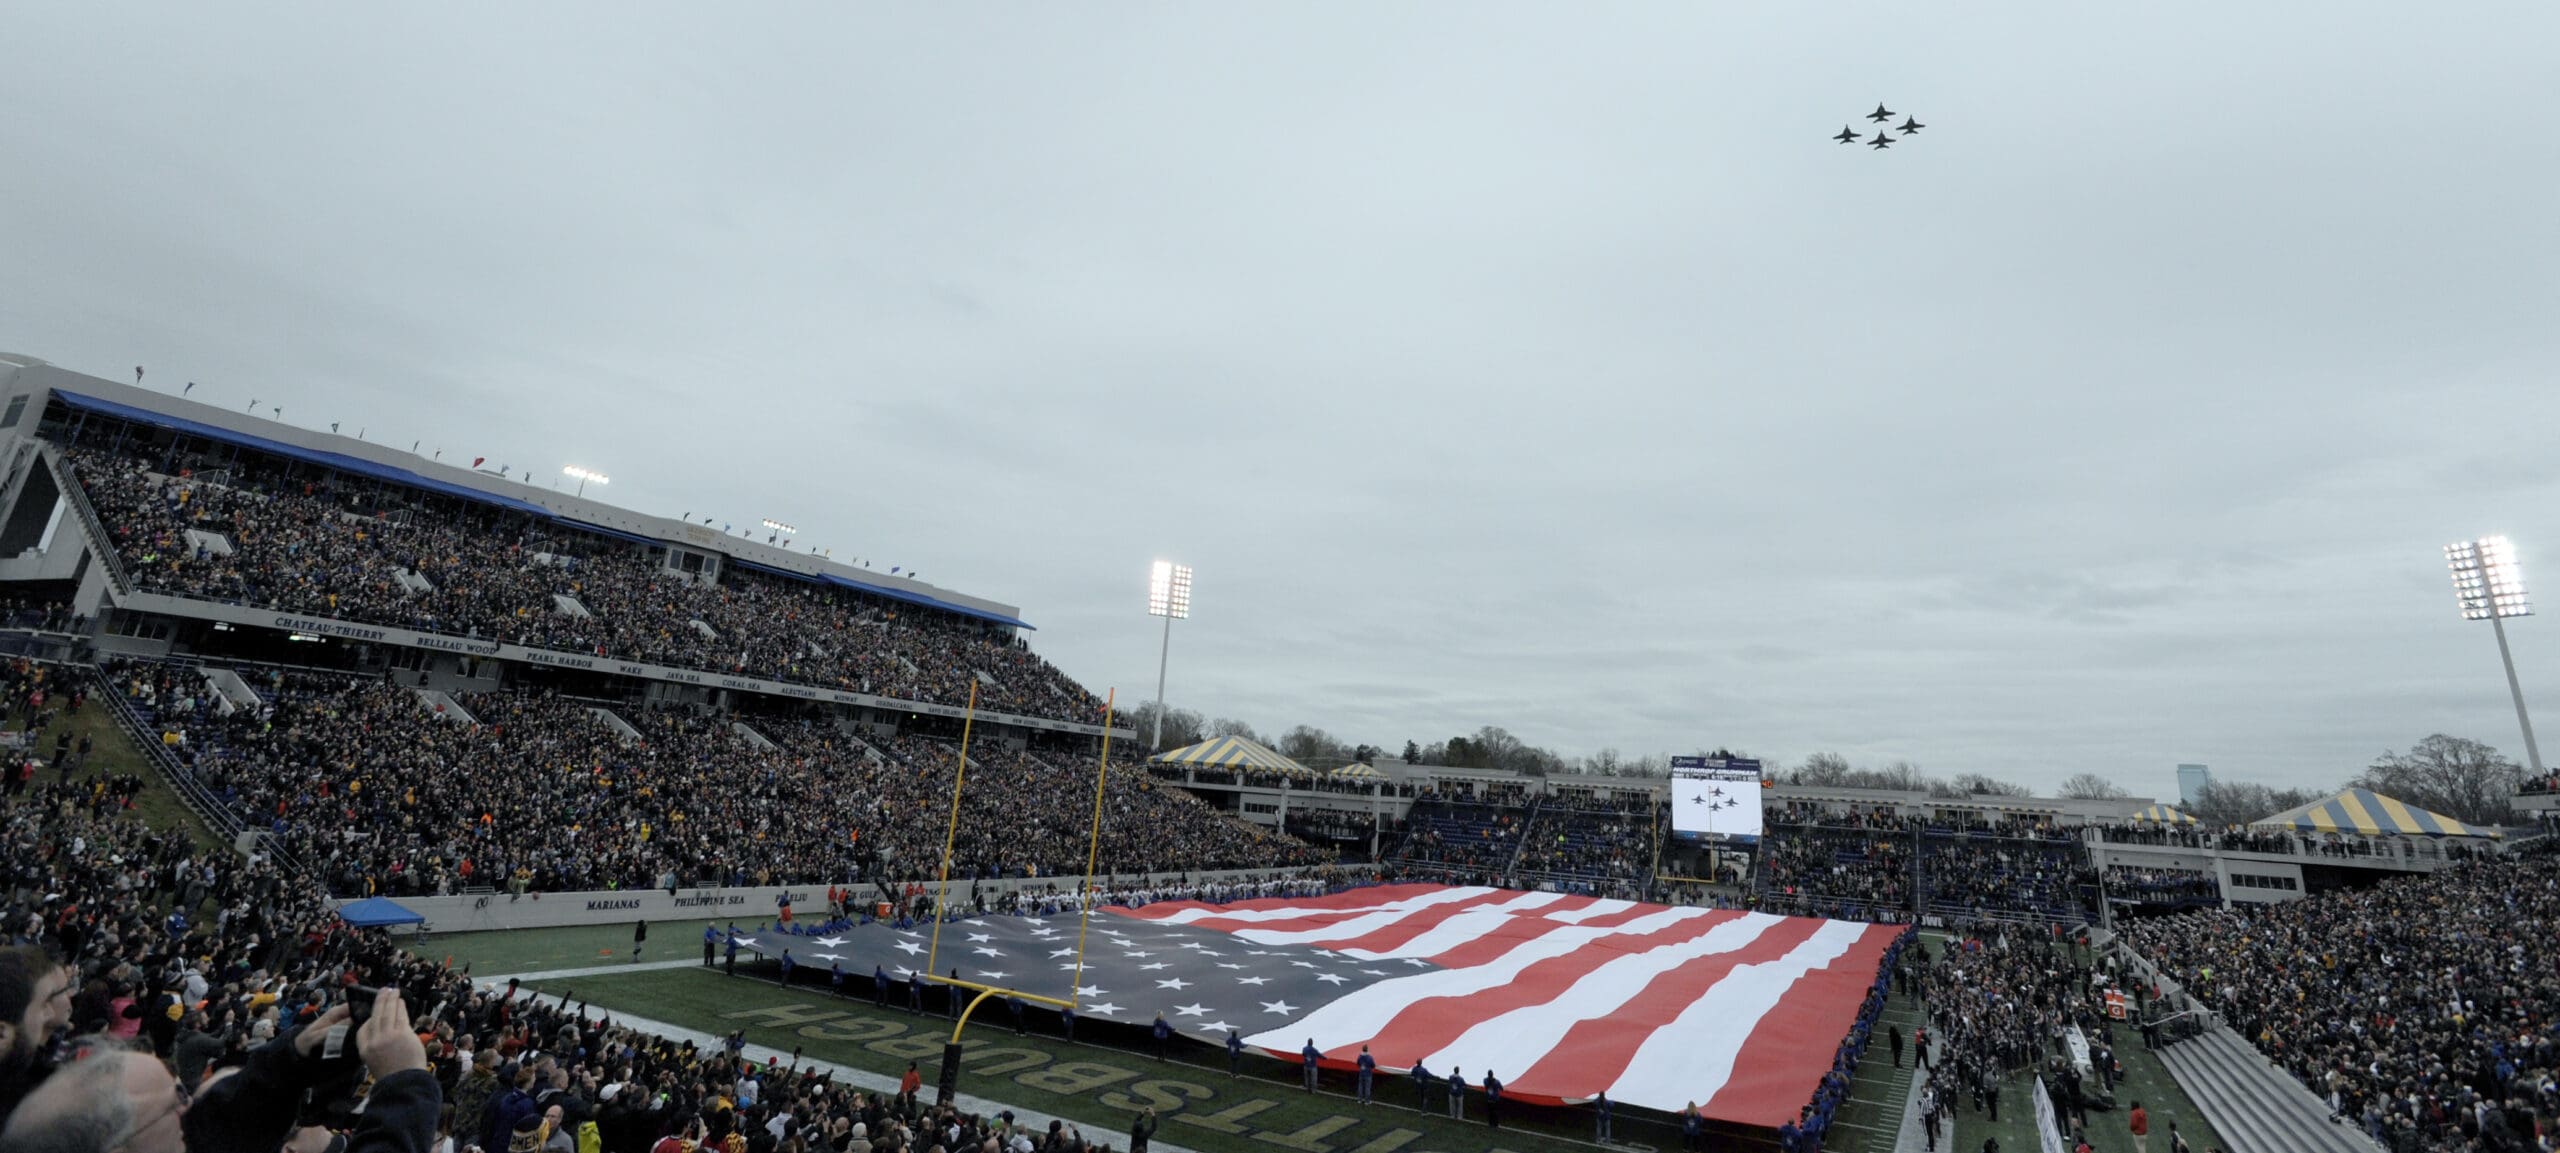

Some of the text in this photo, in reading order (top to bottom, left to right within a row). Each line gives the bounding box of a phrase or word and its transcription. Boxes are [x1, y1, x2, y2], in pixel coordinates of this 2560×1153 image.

[416, 637, 497, 655] BELLEAU WOOD
[526, 652, 593, 668] PEARL HARBOR
[619, 664, 643, 675] WAKE
[665, 671, 700, 683] JAVA SEA
[722, 679, 761, 690] CORAL SEA
[586, 899, 641, 911] MARIANAS
[674, 896, 745, 907] PHILIPPINE SEA
[718, 1003, 1526, 1153] ITTSBURGH
